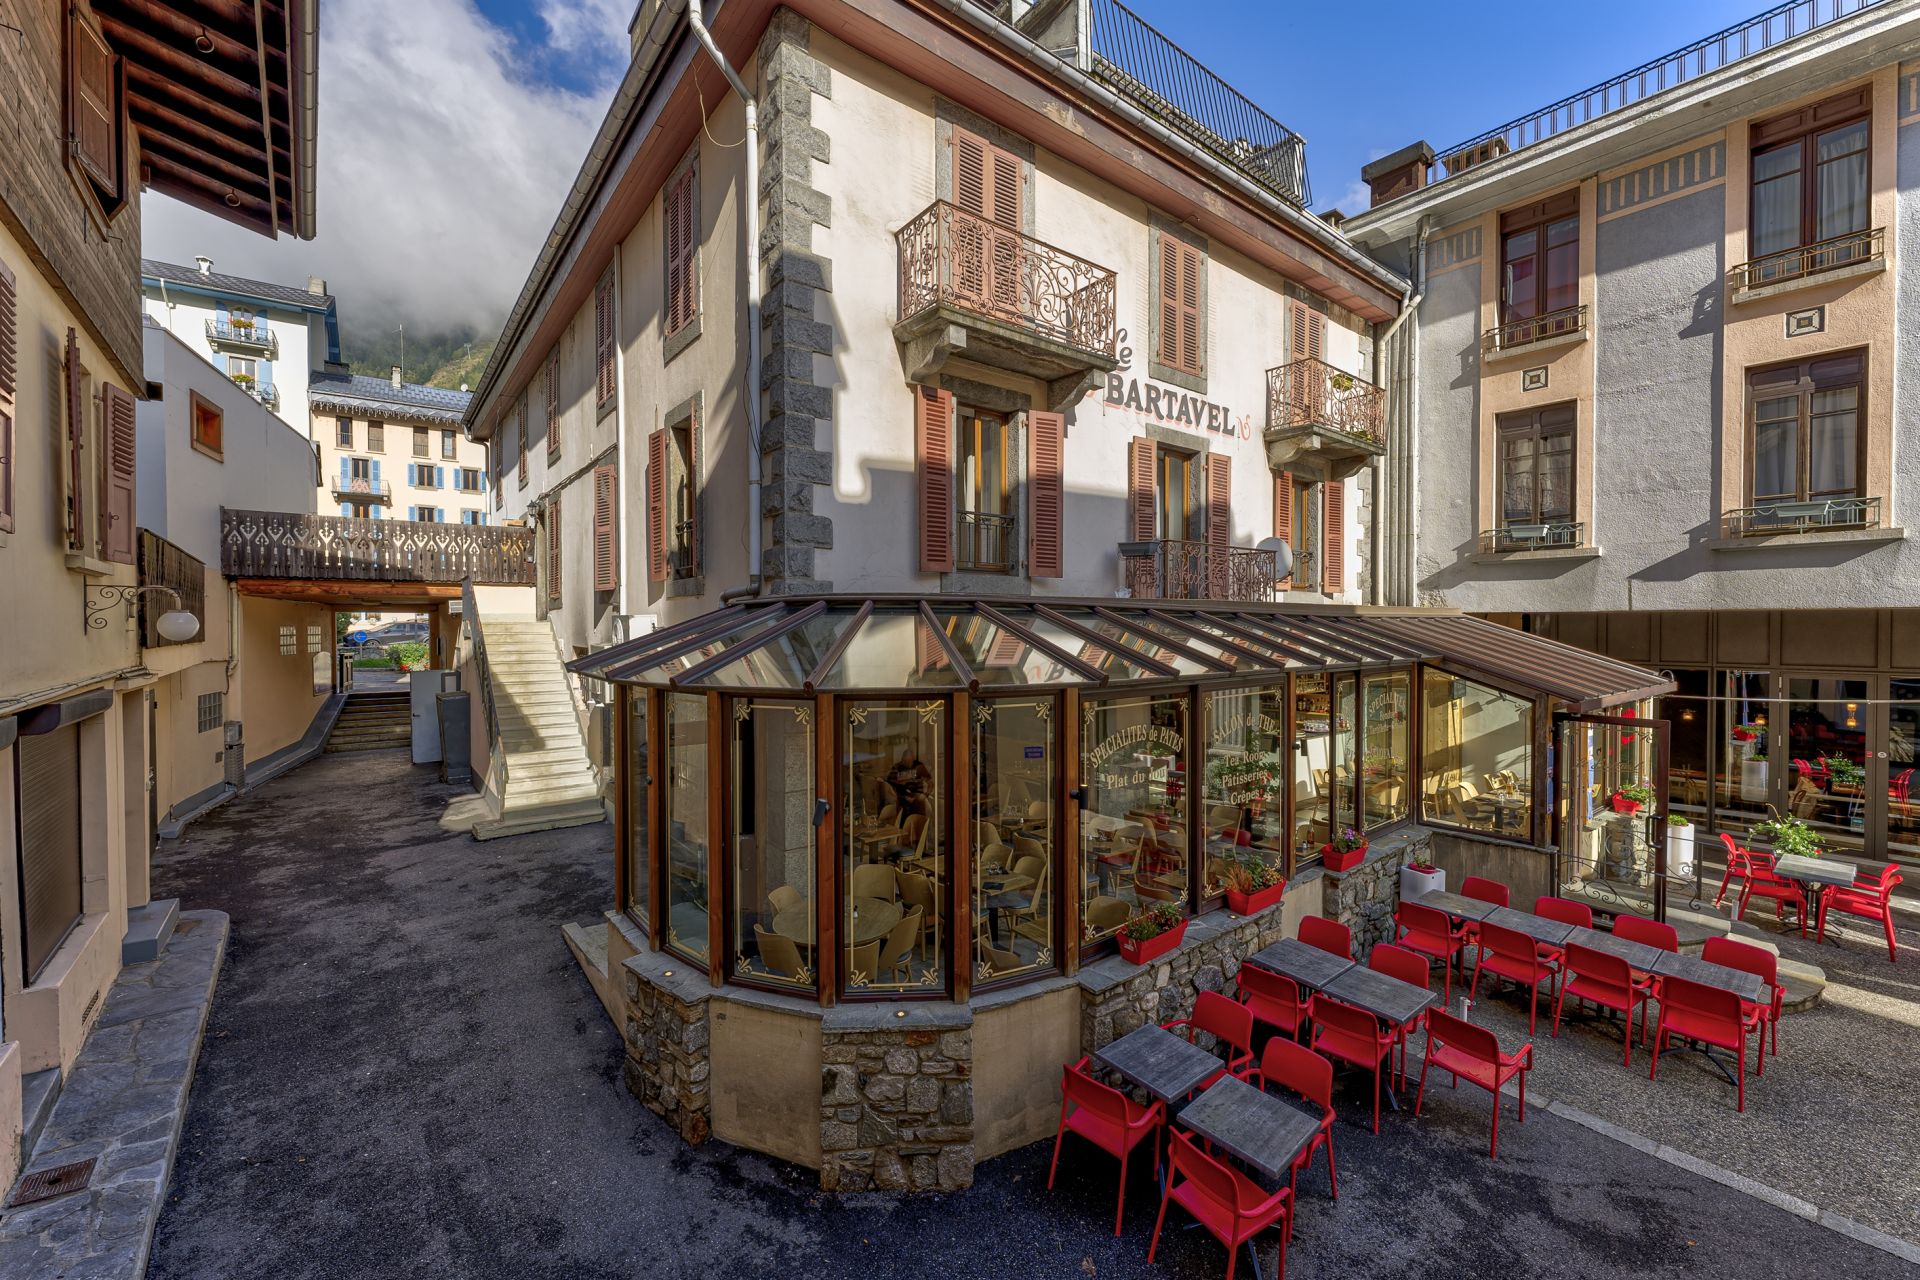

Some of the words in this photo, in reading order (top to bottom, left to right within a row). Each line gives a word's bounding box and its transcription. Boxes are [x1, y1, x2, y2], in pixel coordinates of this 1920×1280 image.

[1106, 372, 1235, 437] BARTAVEL
[1213, 712, 1244, 744] SALON
[1090, 724, 1147, 768] SPECIALITES
[1148, 725, 1158, 742] de
[1160, 726, 1184, 753] PATES
[1223, 752, 1240, 767] Tea
[1106, 773, 1128, 790] Plat
[1132, 770, 1145, 785] du
[1222, 768, 1268, 788] Pâtisseries
[1231, 789, 1260, 805] Crêpes
